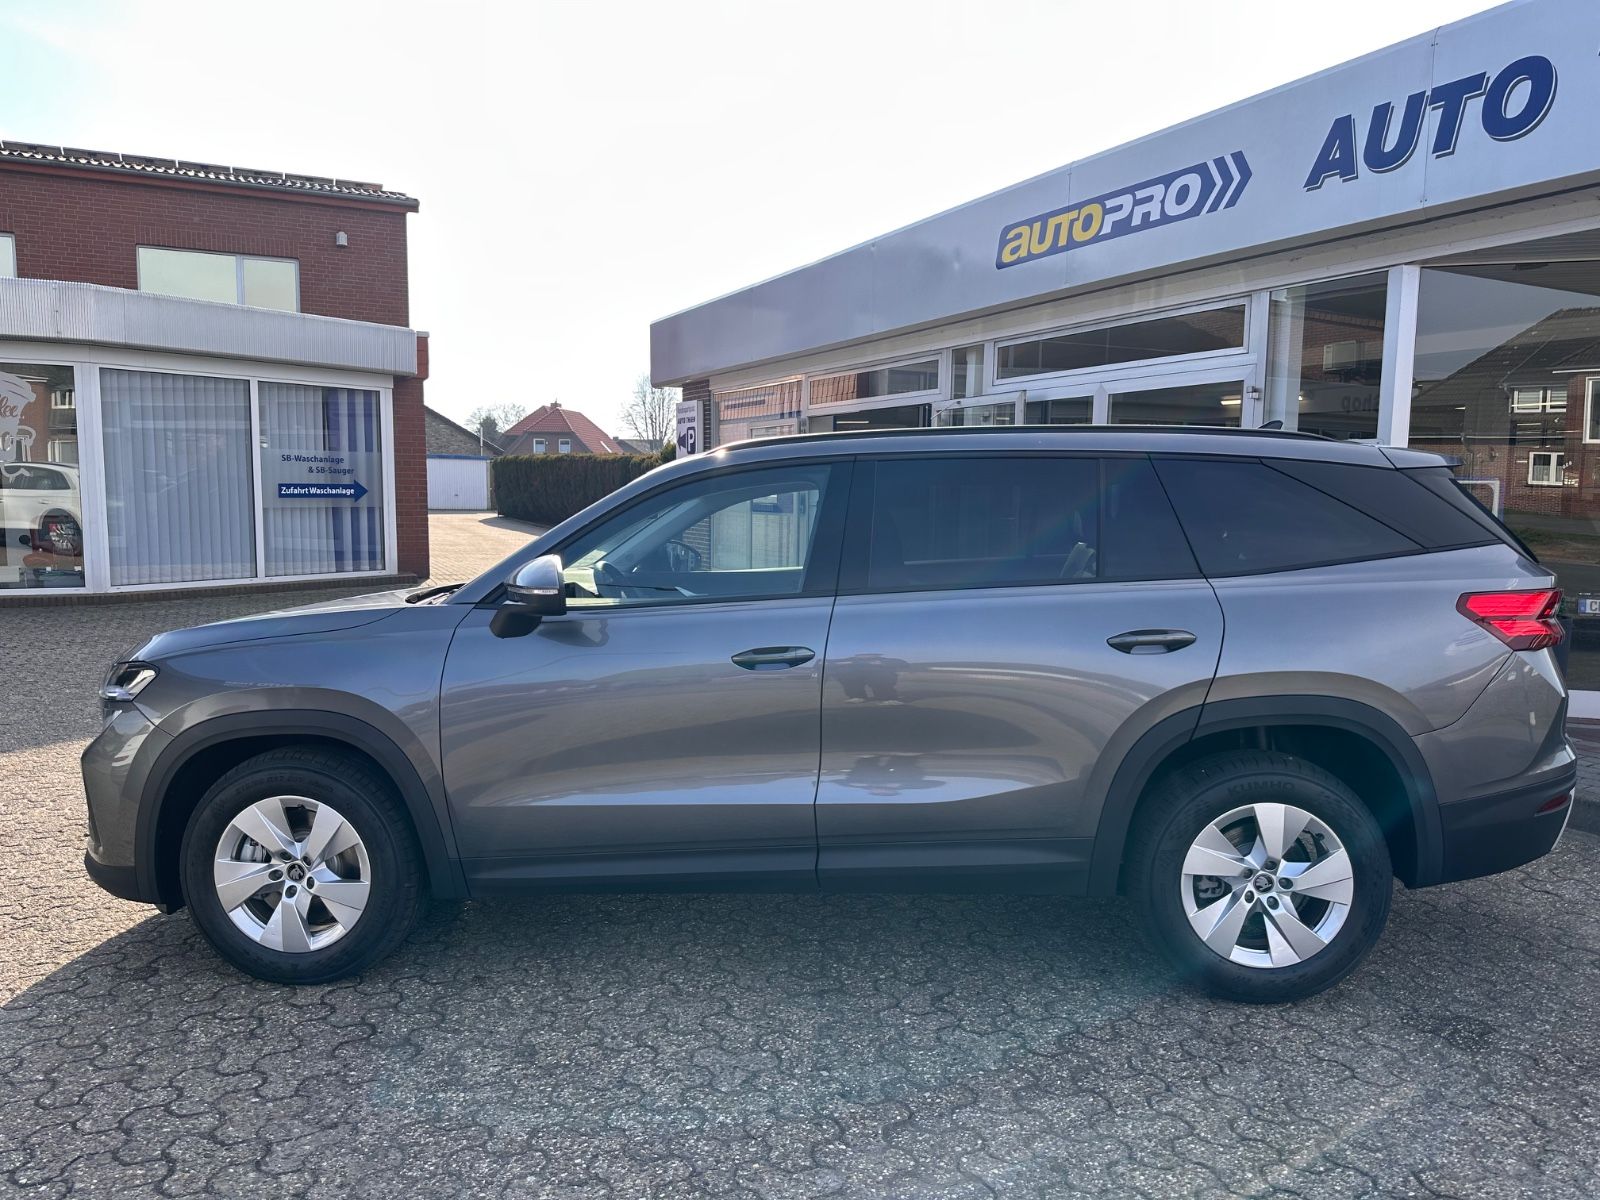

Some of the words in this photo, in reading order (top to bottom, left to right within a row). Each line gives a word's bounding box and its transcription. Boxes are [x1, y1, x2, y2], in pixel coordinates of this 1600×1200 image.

[1303, 55, 1558, 191] AUTO
[281, 454, 345, 463] SB-Waschanlage
[308, 466, 314, 474] &
[315, 466, 354, 475] SB-Sauger
[280, 486, 309, 495] Zufahrt
[309, 486, 355, 496] Waschanlage
